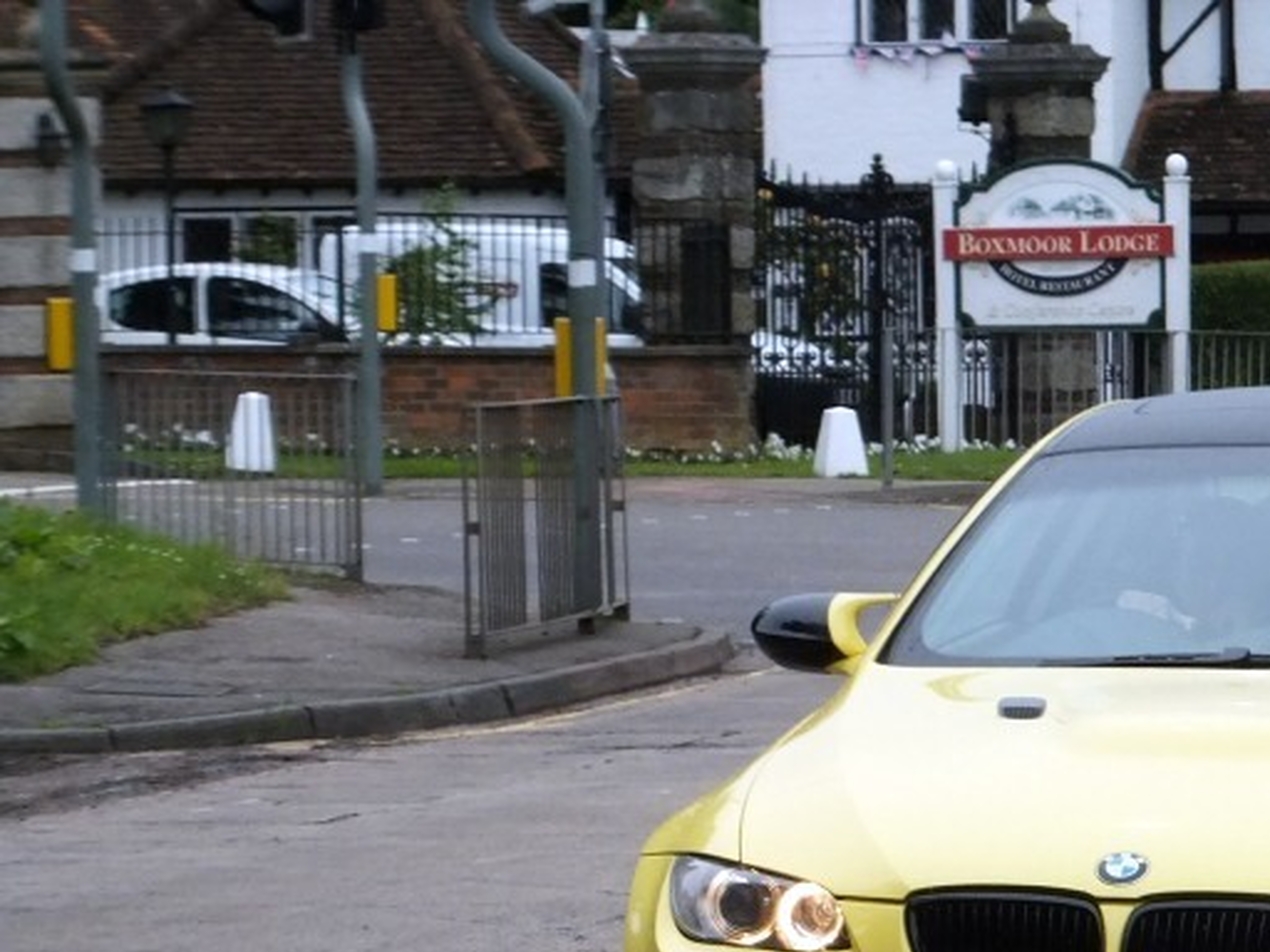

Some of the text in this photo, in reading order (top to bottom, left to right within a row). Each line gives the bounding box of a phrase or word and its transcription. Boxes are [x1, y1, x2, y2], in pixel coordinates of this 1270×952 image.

[958, 230, 1160, 255] BOXMOOR LODGE
[1000, 262, 1116, 292] HOTEL RESTAURANT
